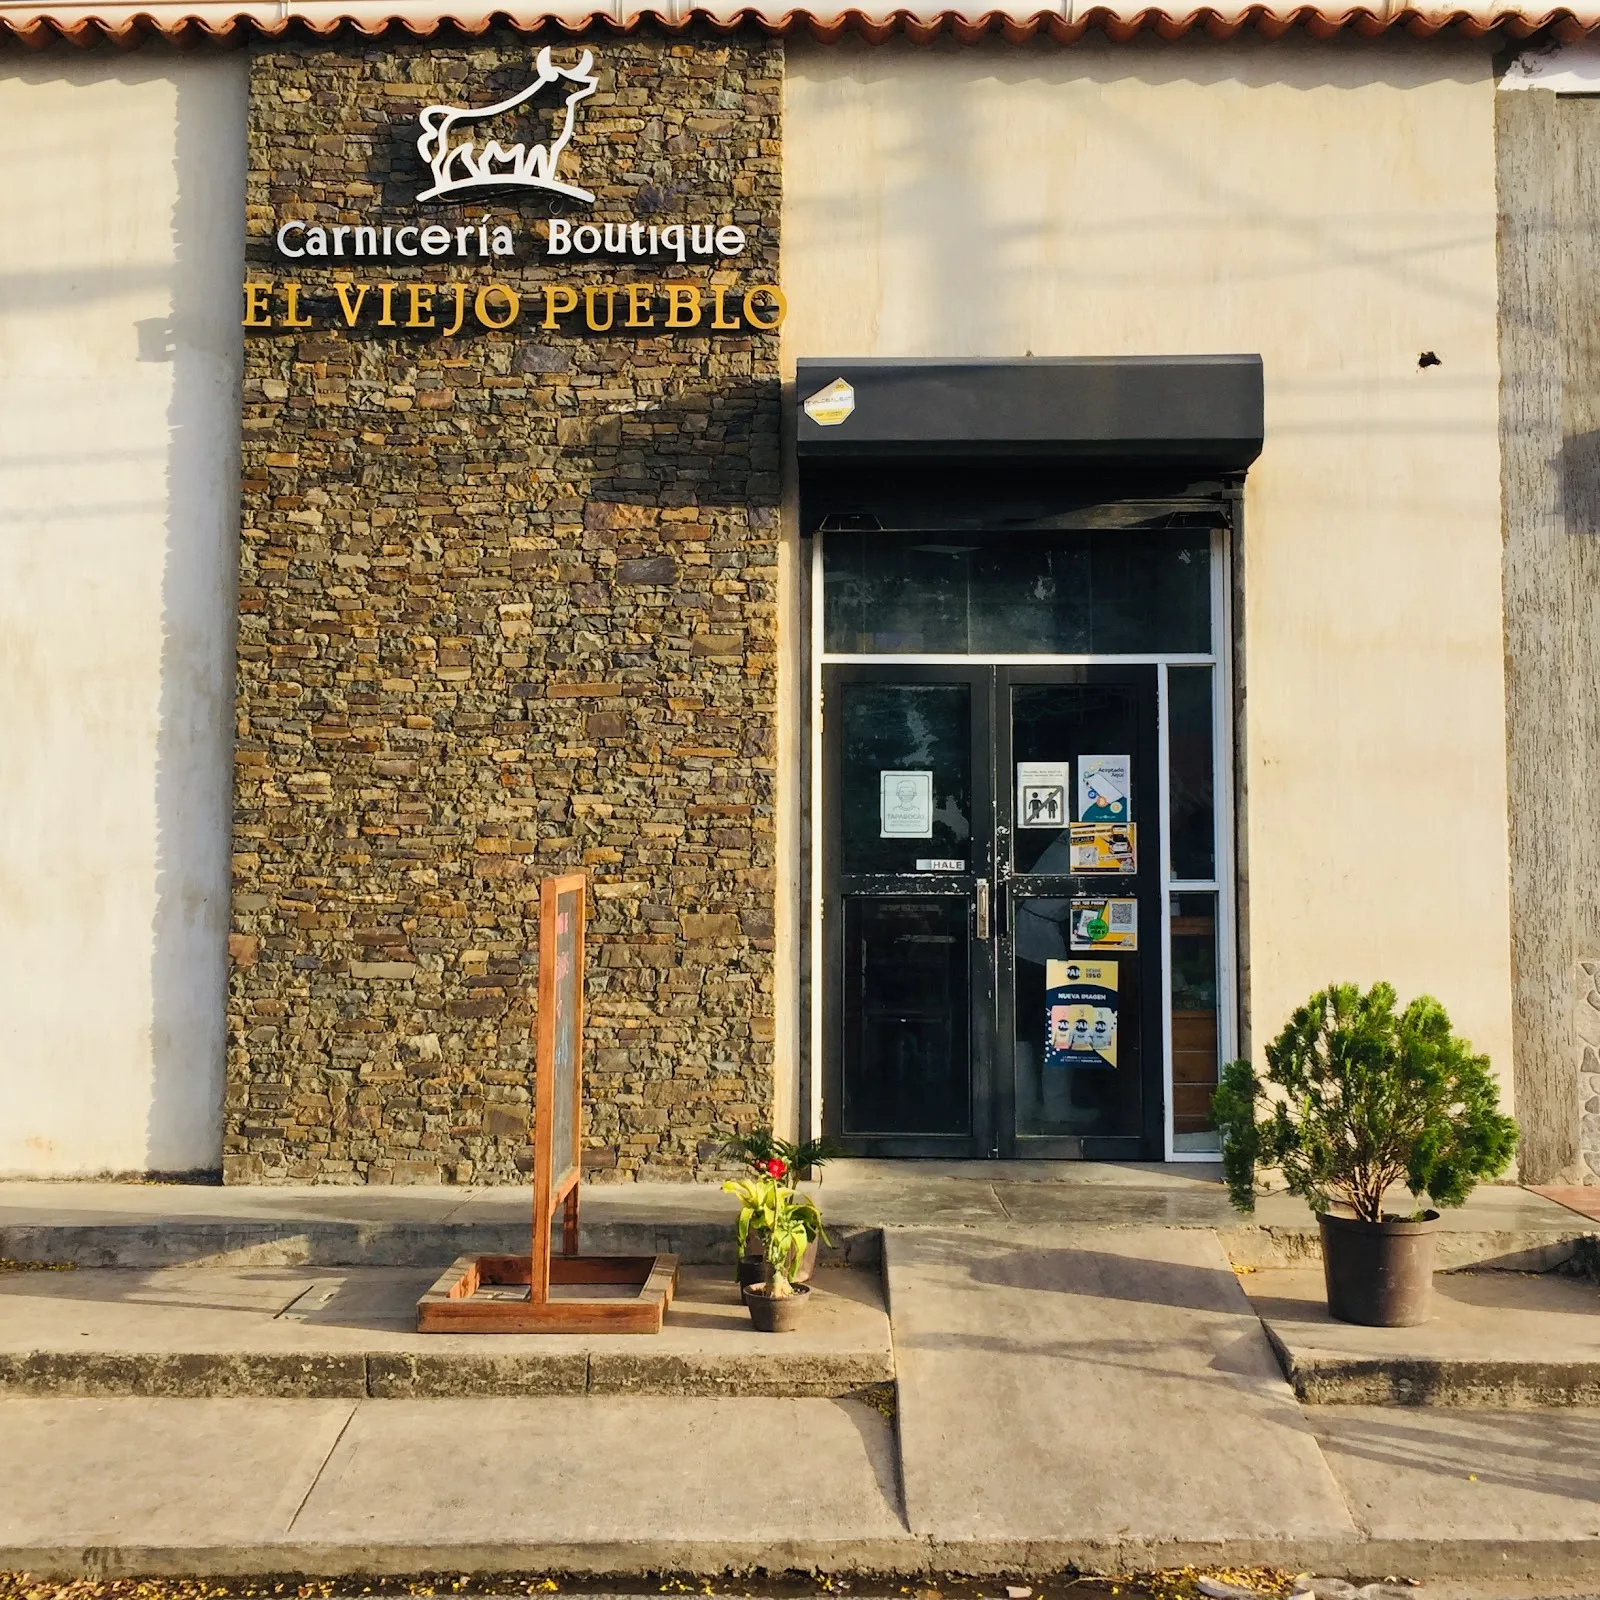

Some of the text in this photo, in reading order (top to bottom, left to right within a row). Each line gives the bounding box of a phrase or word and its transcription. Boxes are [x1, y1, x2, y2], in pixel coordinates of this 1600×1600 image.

[276, 214, 746, 263] Carnicería Boutique
[241, 282, 788, 336] EL VIEJO PUEBLO
[933, 861, 963, 869] HALE
[1081, 993, 1106, 1001] IMAGEN
